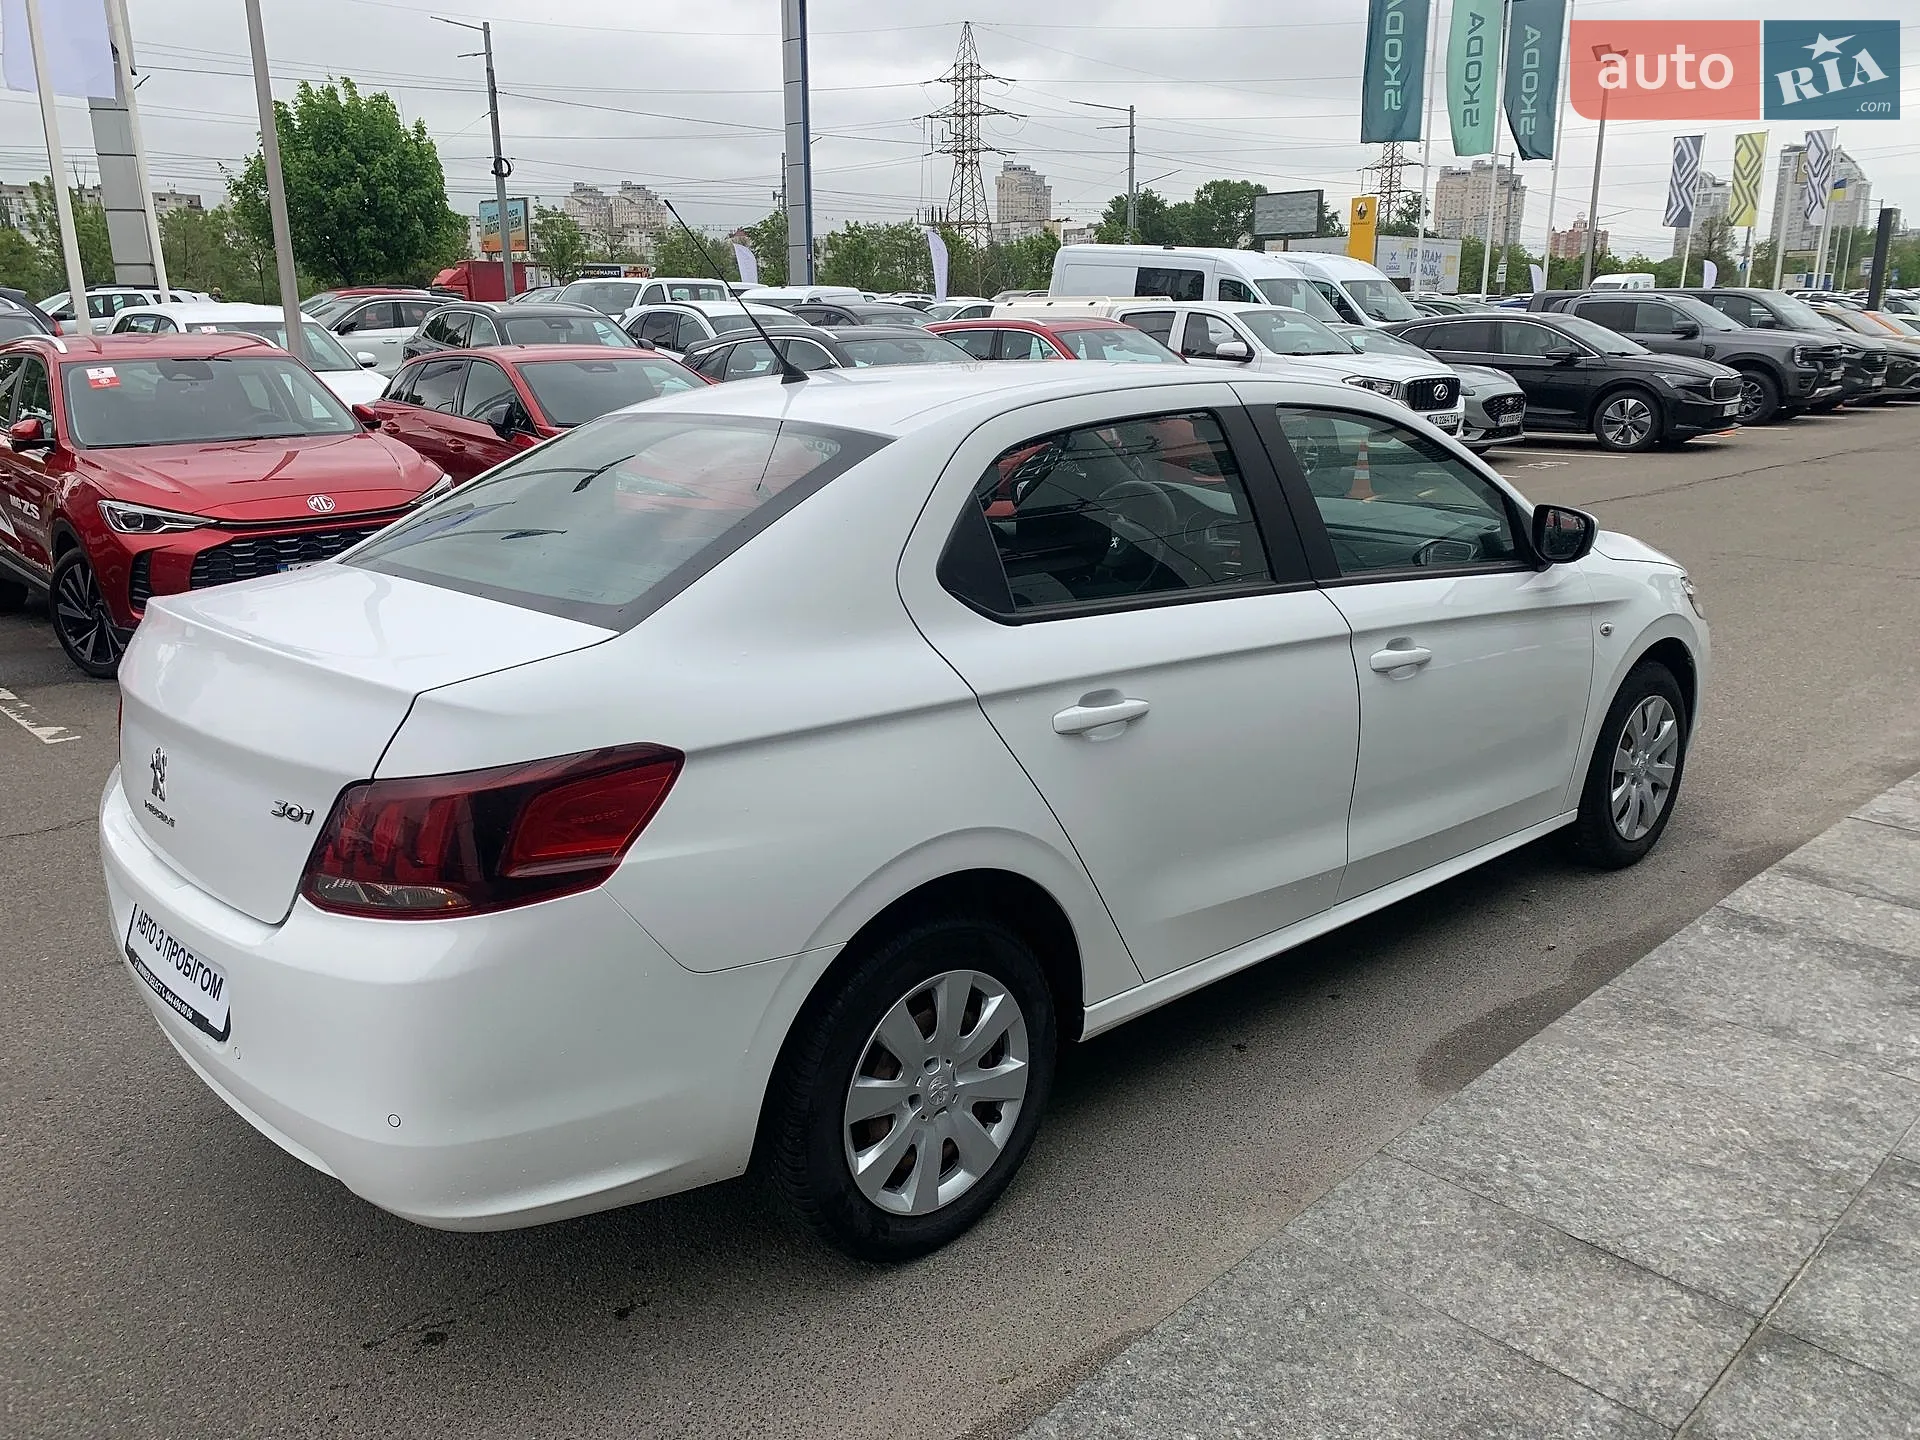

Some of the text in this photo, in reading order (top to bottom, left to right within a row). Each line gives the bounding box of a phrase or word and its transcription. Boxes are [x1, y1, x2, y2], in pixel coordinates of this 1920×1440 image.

[20, 498, 40, 520] ZS
[308, 495, 335, 512] MG
[270, 799, 315, 825] 301
[136, 909, 157, 945] АВТО
[162, 935, 224, 1002] ПРОБІГОМ
